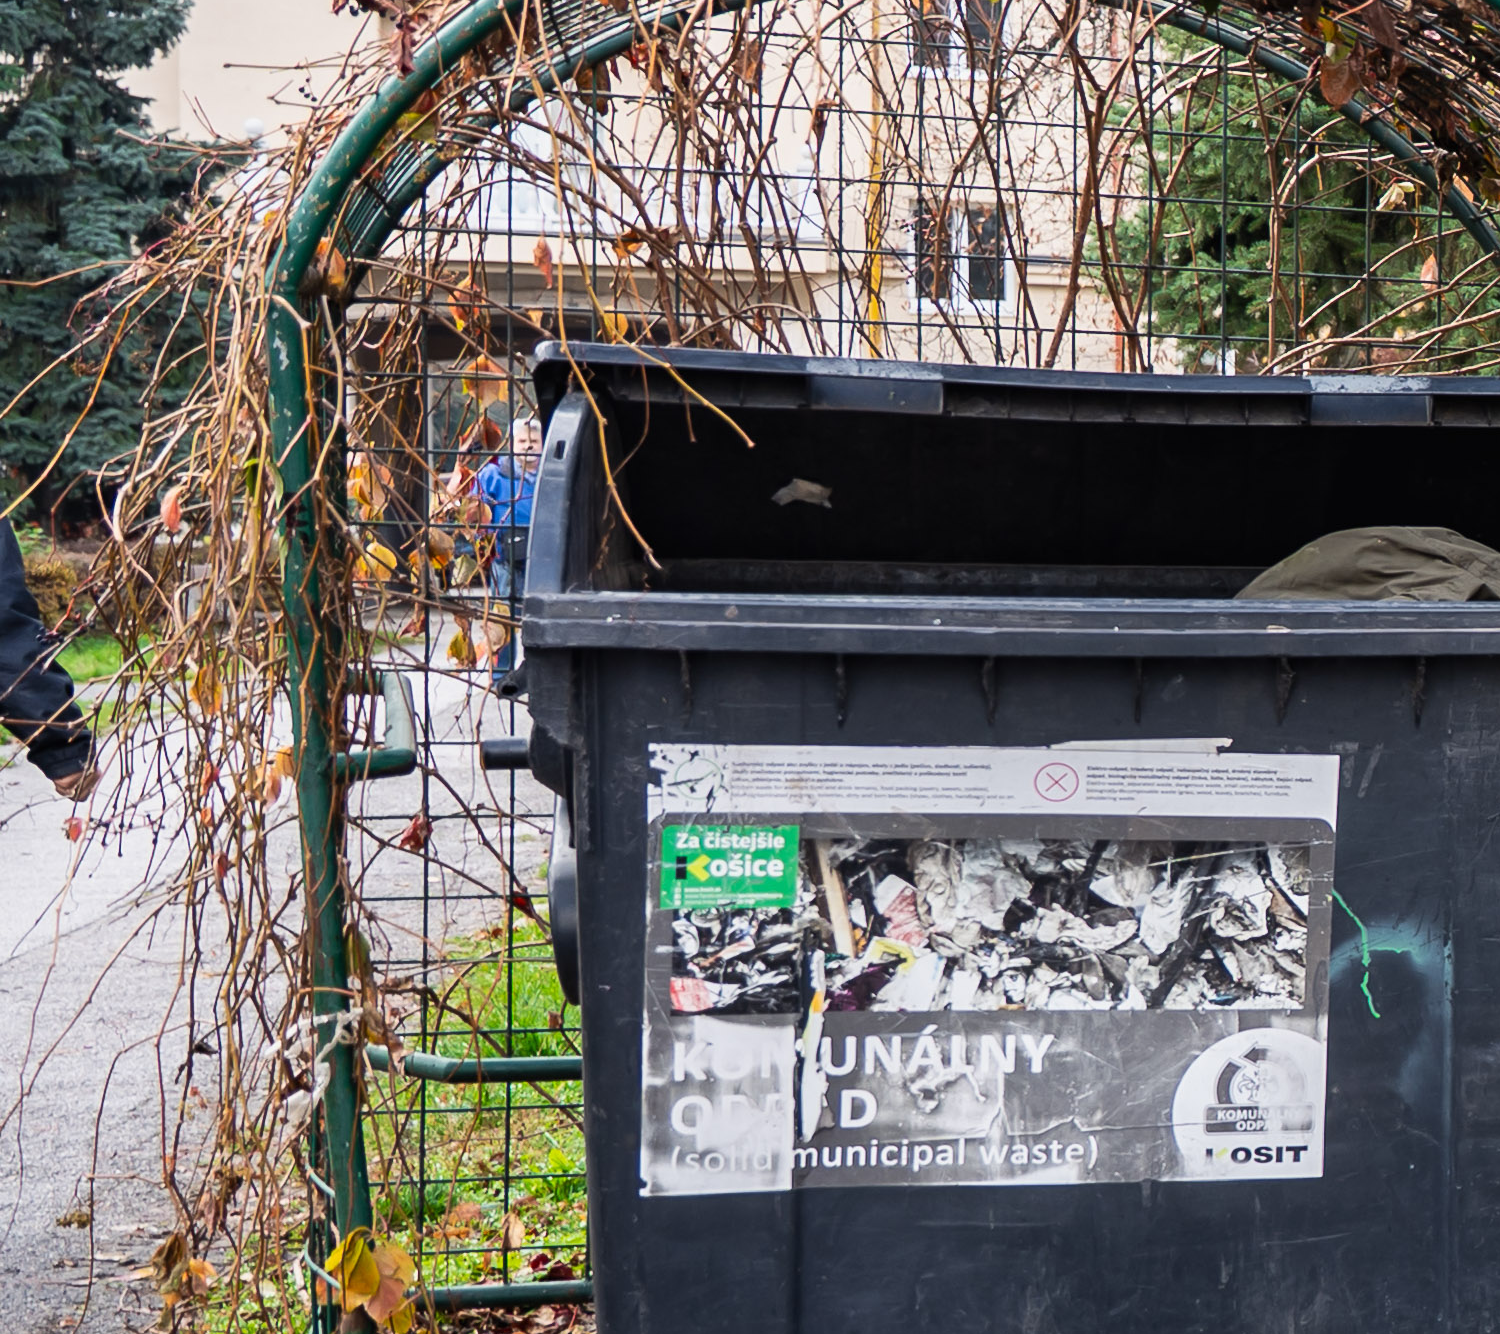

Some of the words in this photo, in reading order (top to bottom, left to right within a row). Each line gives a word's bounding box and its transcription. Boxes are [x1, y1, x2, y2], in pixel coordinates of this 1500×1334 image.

[676, 832, 700, 849] Za
[703, 832, 785, 853] čistejšie
[792, 1137, 967, 1170] municipal
[979, 1133, 1100, 1170] waste)
